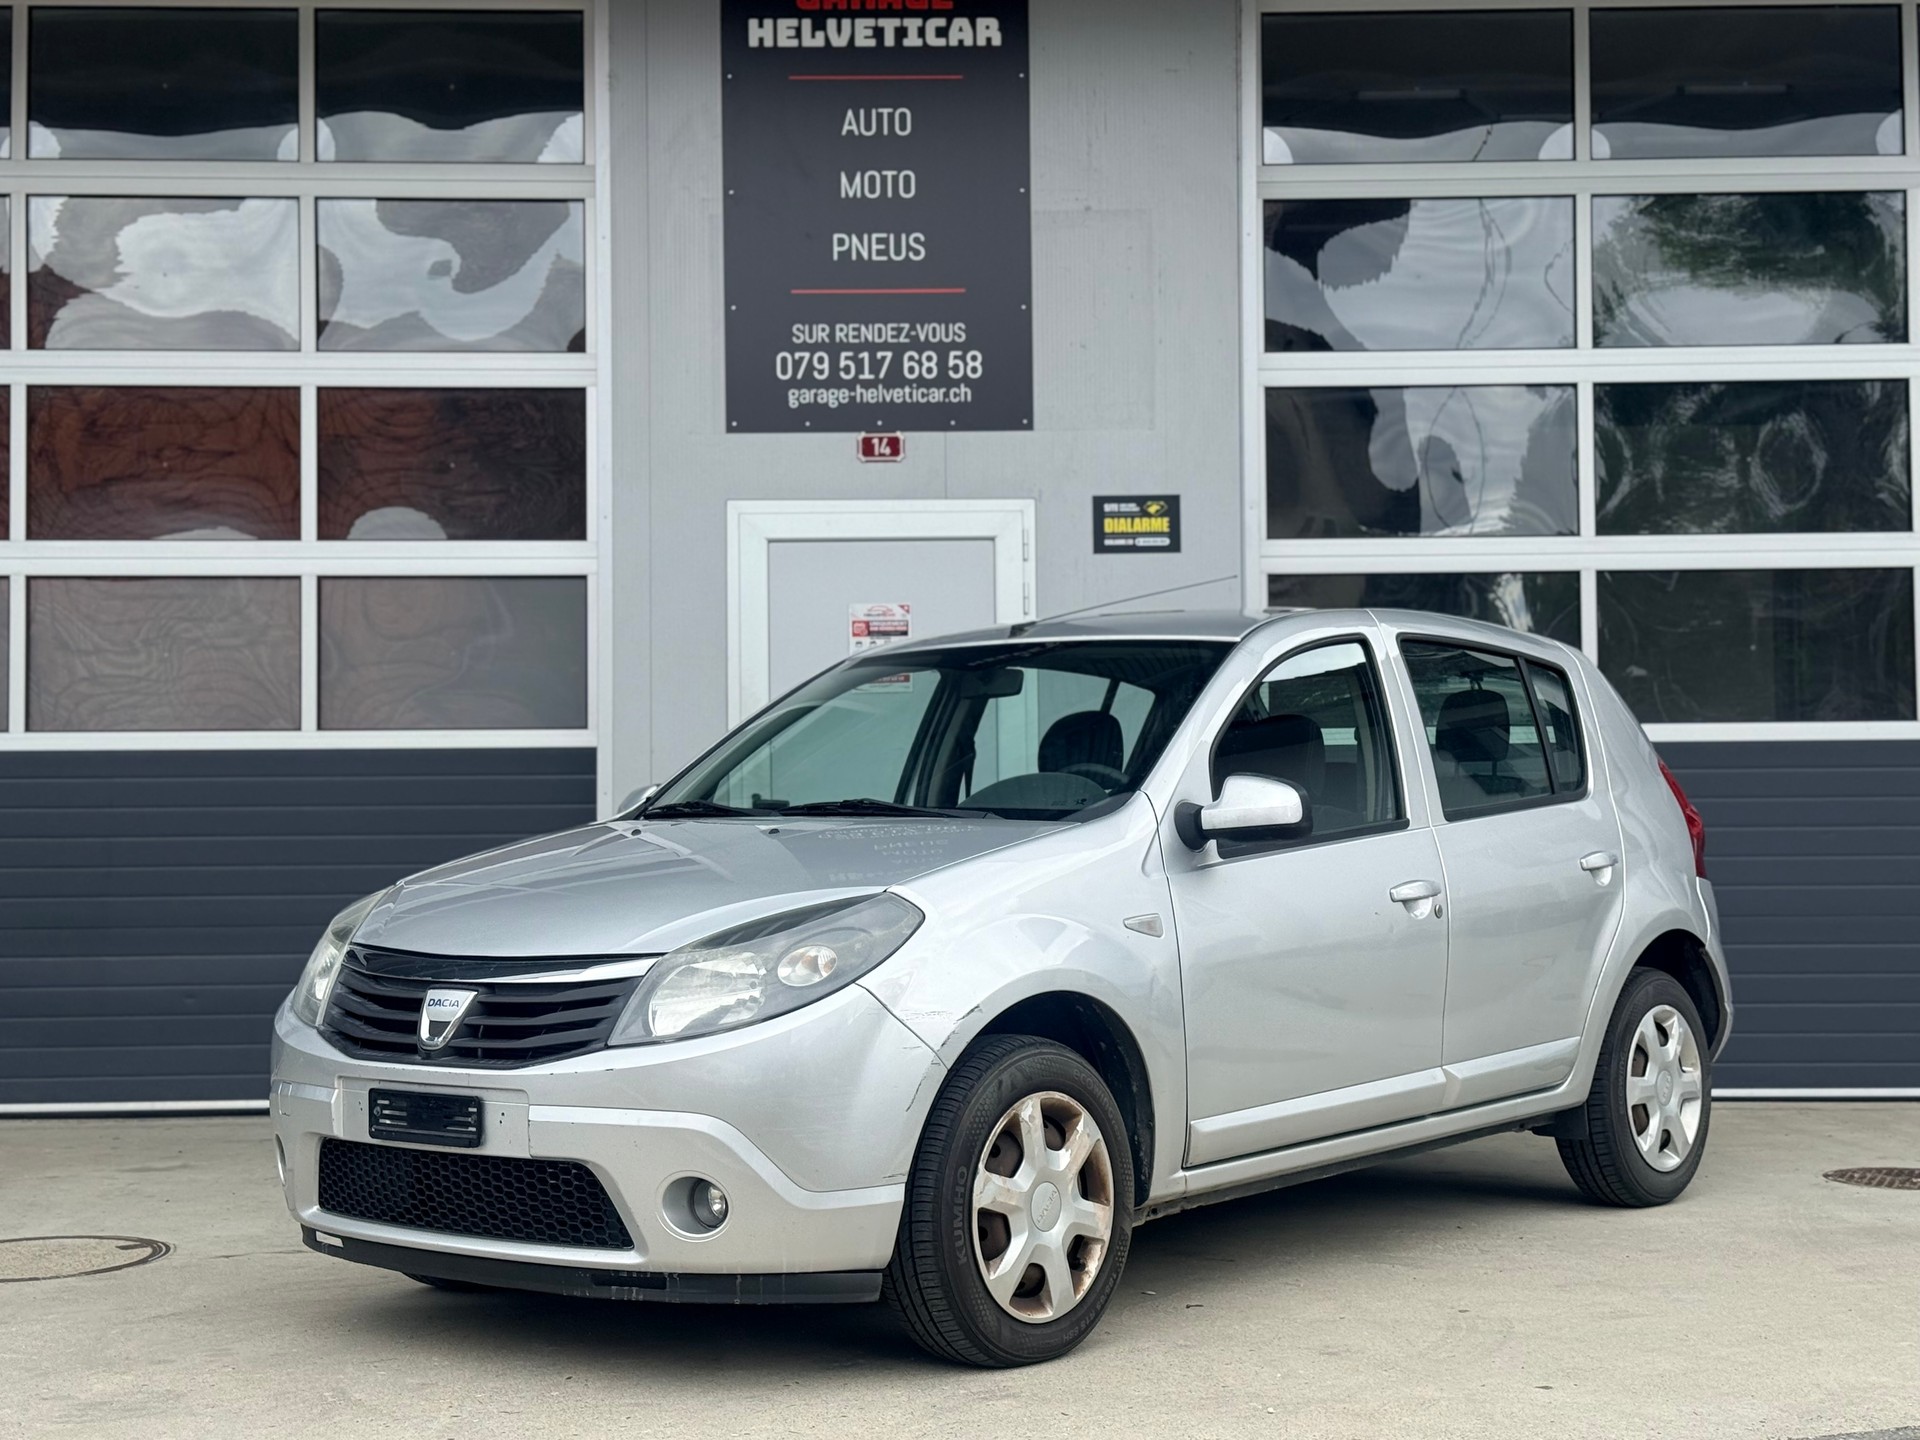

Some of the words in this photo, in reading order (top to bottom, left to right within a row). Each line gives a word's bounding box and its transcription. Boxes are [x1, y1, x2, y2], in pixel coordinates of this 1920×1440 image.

[748, 18, 1002, 47] HELVETICAR
[841, 107, 912, 137] AUTO
[840, 170, 916, 199] MOTO
[832, 232, 926, 261] PNEUS
[792, 323, 830, 344] SUR
[835, 322, 966, 344] RENDEZ-VOUS
[775, 351, 830, 380] 079
[839, 350, 893, 380] 517
[902, 350, 938, 380] 68
[948, 350, 983, 380] 58
[788, 383, 972, 409] garage-helveticar.ch
[871, 437, 891, 456] 14
[1103, 516, 1170, 533] DIALARME
[427, 998, 460, 1008] DACIA
[953, 1165, 968, 1266] KUMHO
